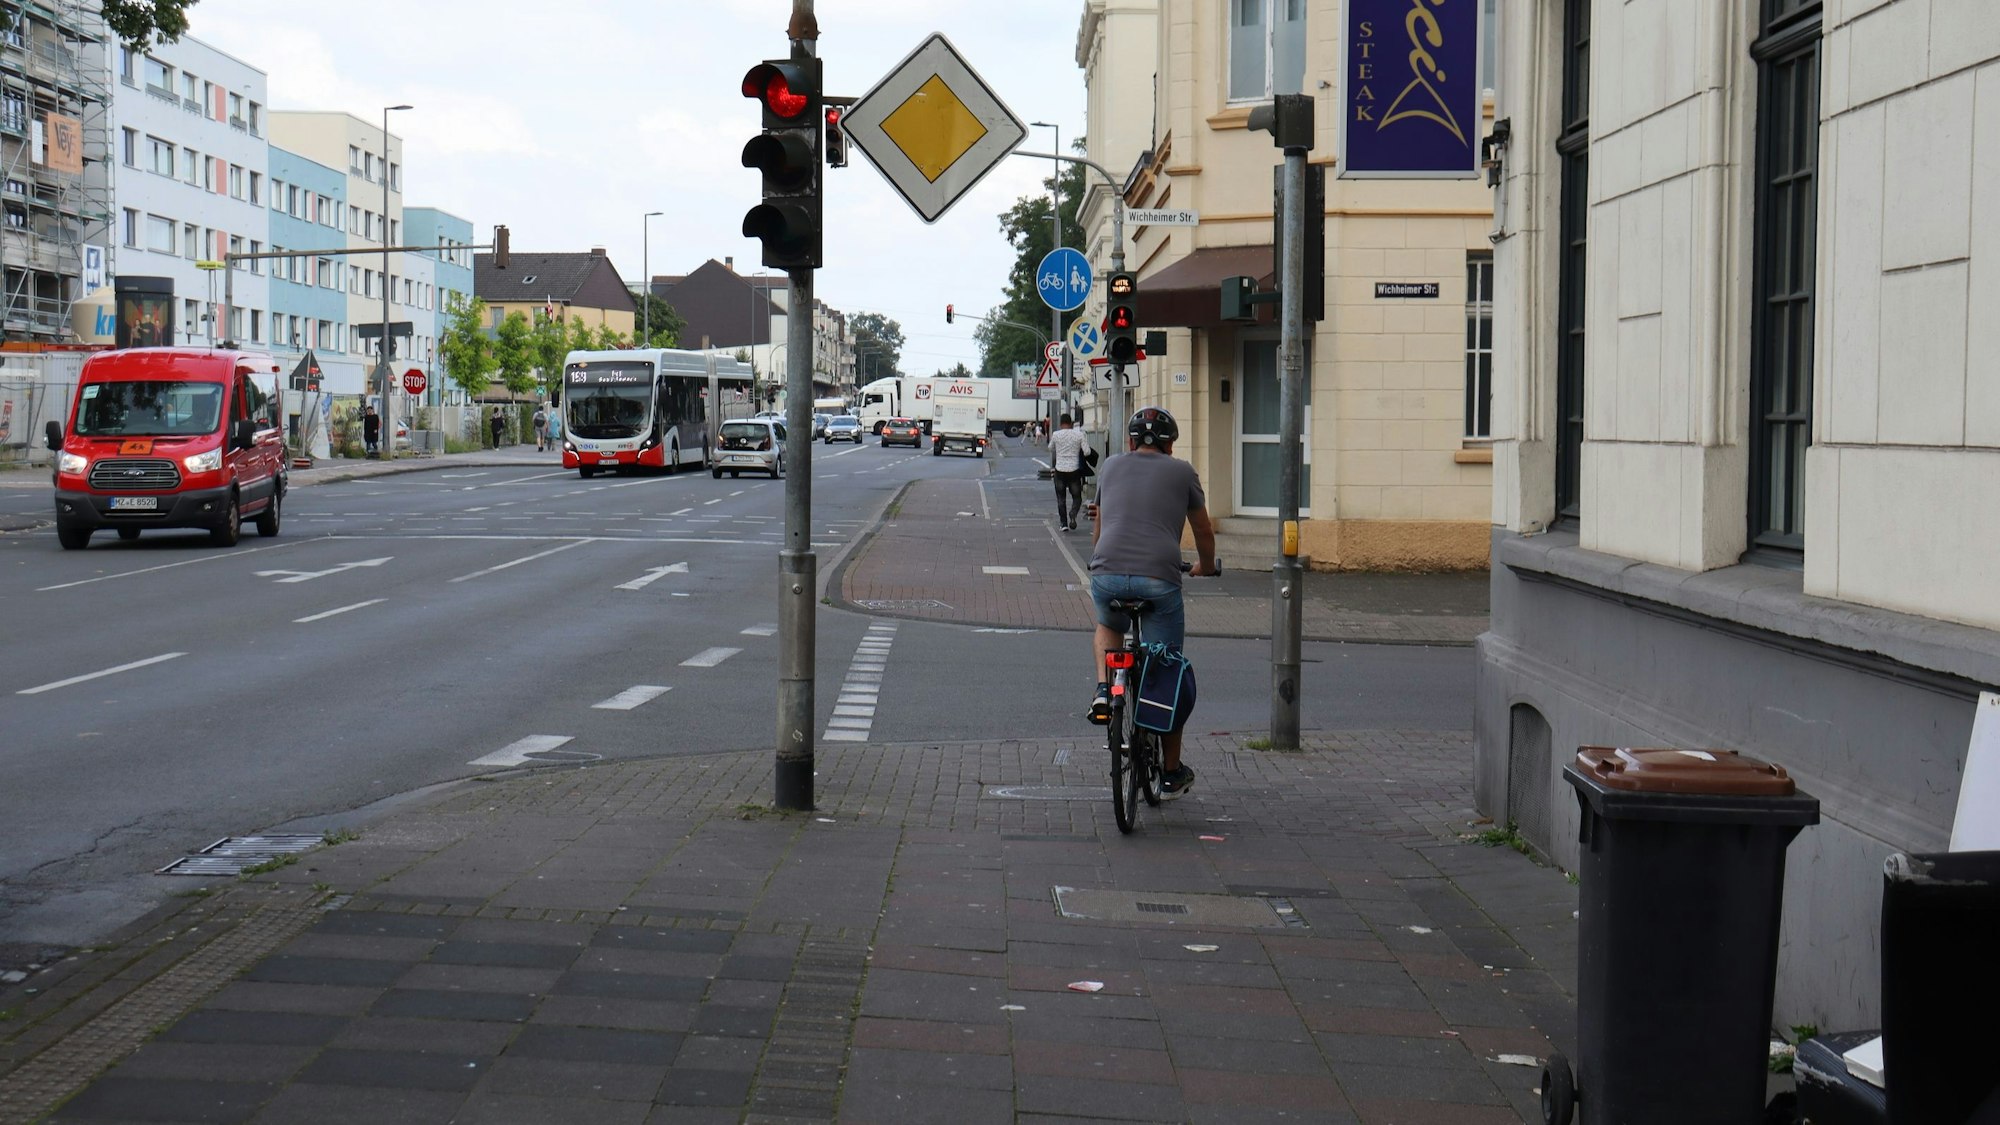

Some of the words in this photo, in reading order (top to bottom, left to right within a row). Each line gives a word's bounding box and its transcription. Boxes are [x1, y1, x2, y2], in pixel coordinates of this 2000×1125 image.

[1355, 21, 1376, 121] STEAK
[1128, 211, 1177, 222] Wichheimer
[1179, 212, 1194, 223] Str.
[1377, 284, 1422, 294] Wichheimer
[1423, 284, 1437, 294] Str.
[404, 376, 426, 387] STOP
[1175, 374, 1187, 382] 180
[918, 389, 930, 397] TIP
[949, 385, 973, 395] AVIS
